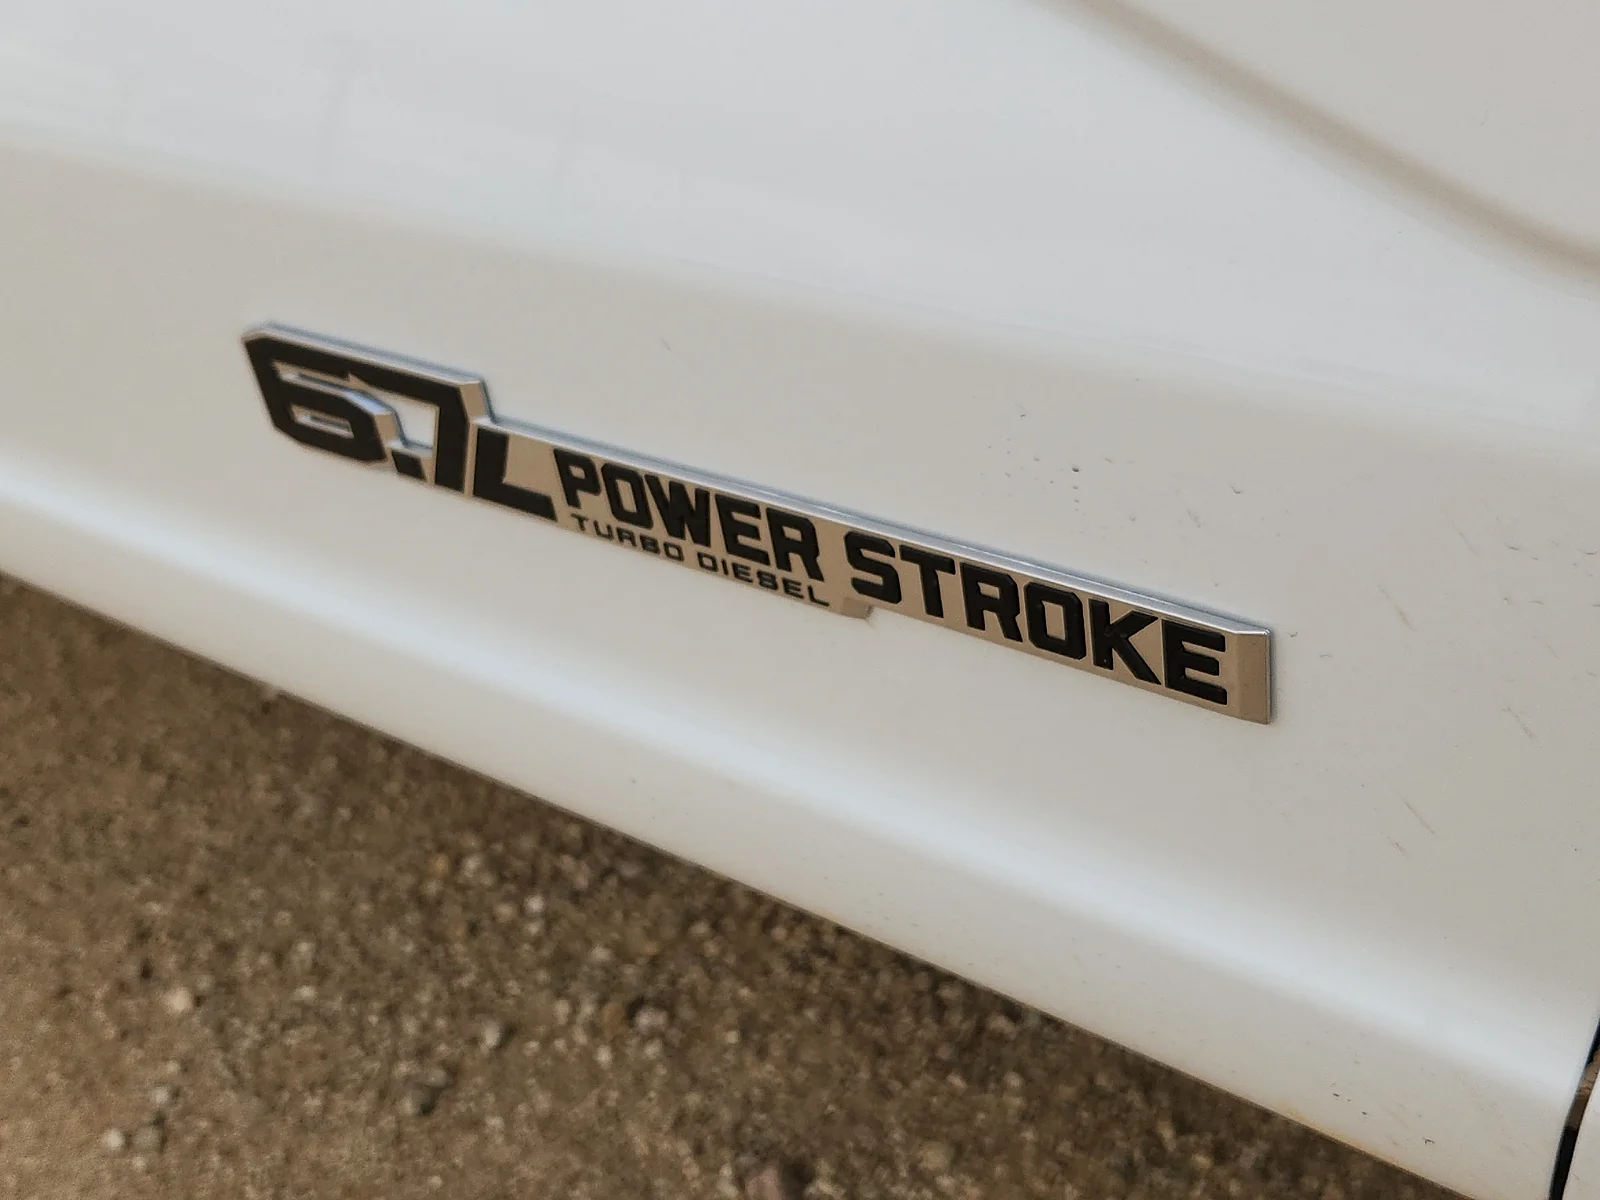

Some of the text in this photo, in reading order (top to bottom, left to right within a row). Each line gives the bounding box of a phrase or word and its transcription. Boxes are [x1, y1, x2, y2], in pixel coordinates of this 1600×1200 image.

[243, 337, 1228, 705] 6.7L POWER STROKE
[570, 513, 830, 607] TURBO DIESEL
